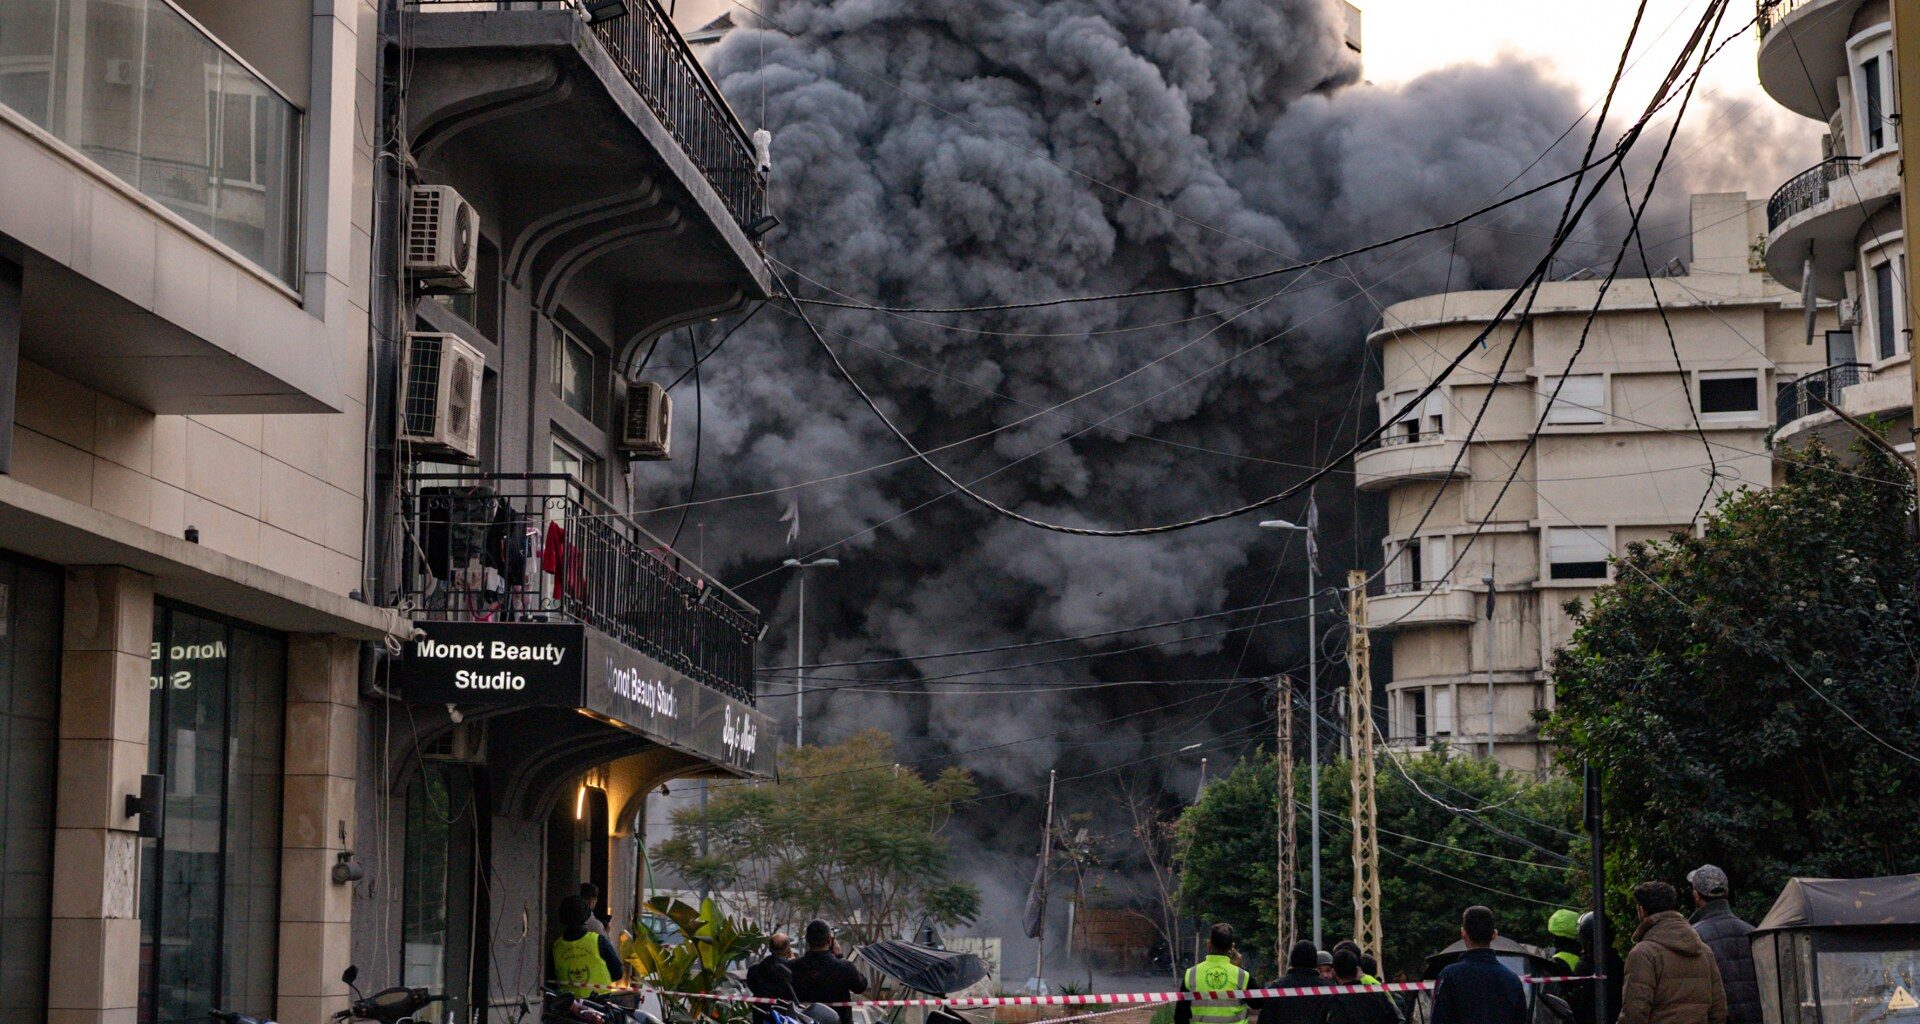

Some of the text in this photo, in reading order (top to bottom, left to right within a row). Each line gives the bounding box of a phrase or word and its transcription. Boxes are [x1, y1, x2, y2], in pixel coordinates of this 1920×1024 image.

[416, 639, 566, 665] Monot Beauty
[455, 669, 526, 690] Studio
[631, 667, 656, 718] Beauty
